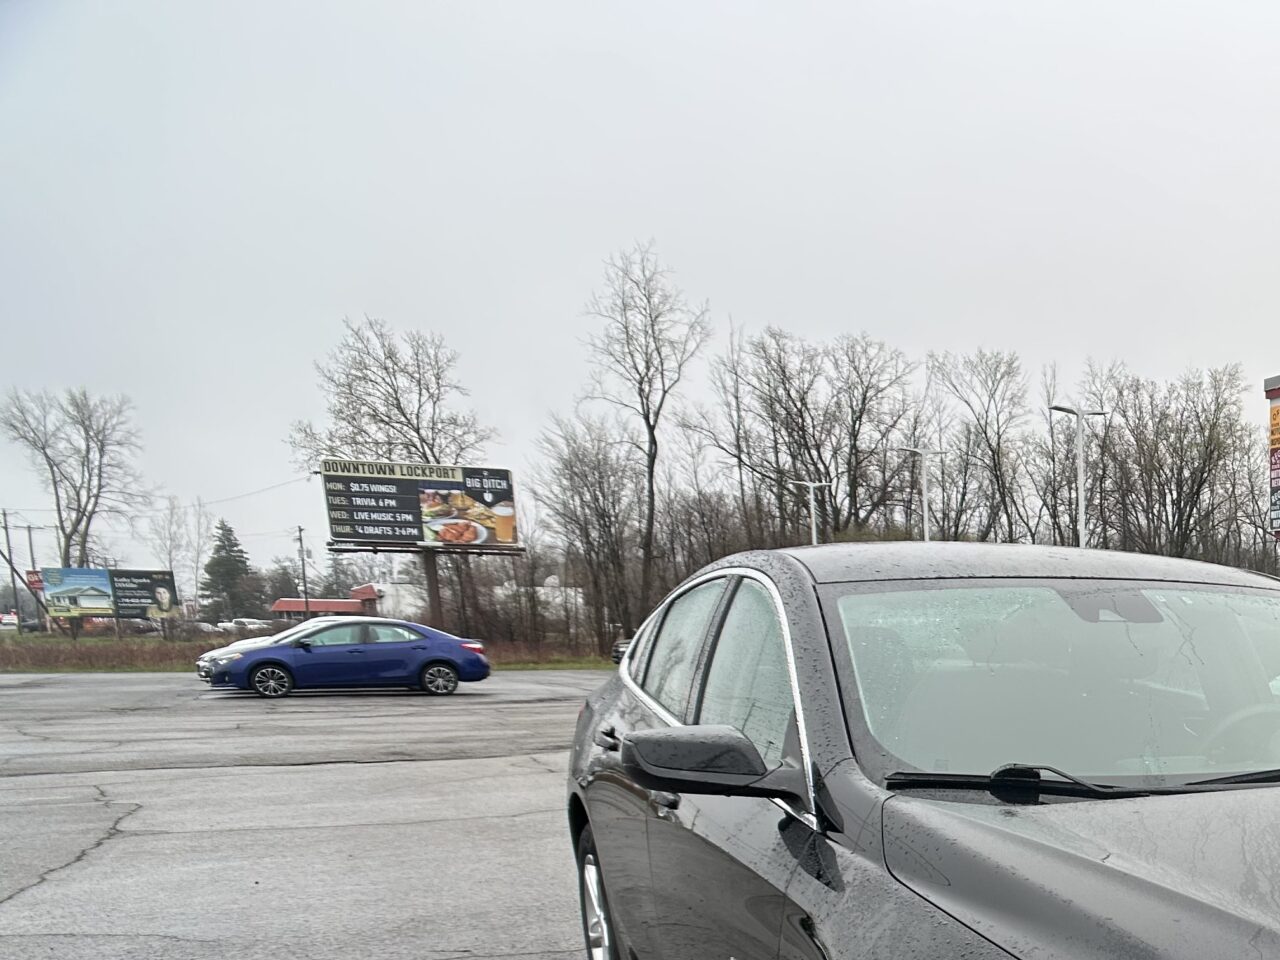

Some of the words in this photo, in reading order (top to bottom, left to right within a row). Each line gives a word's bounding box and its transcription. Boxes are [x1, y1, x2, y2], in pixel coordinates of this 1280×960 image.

[324, 461, 396, 476] DOWNTOWN
[400, 465, 456, 479] LOCKPORT
[326, 482, 346, 491] MON:
[465, 477, 481, 488] BIG
[482, 478, 508, 489] DITCH
[328, 496, 349, 505] TUES:
[351, 497, 376, 506] TRIVIA
[384, 499, 397, 507] PM
[330, 511, 349, 519] WED:
[353, 511, 371, 520] LIVE
[371, 512, 394, 521] MUSIC
[401, 514, 414, 522] PM
[364, 526, 392, 535] DRAFTS
[406, 528, 419, 536] PM
